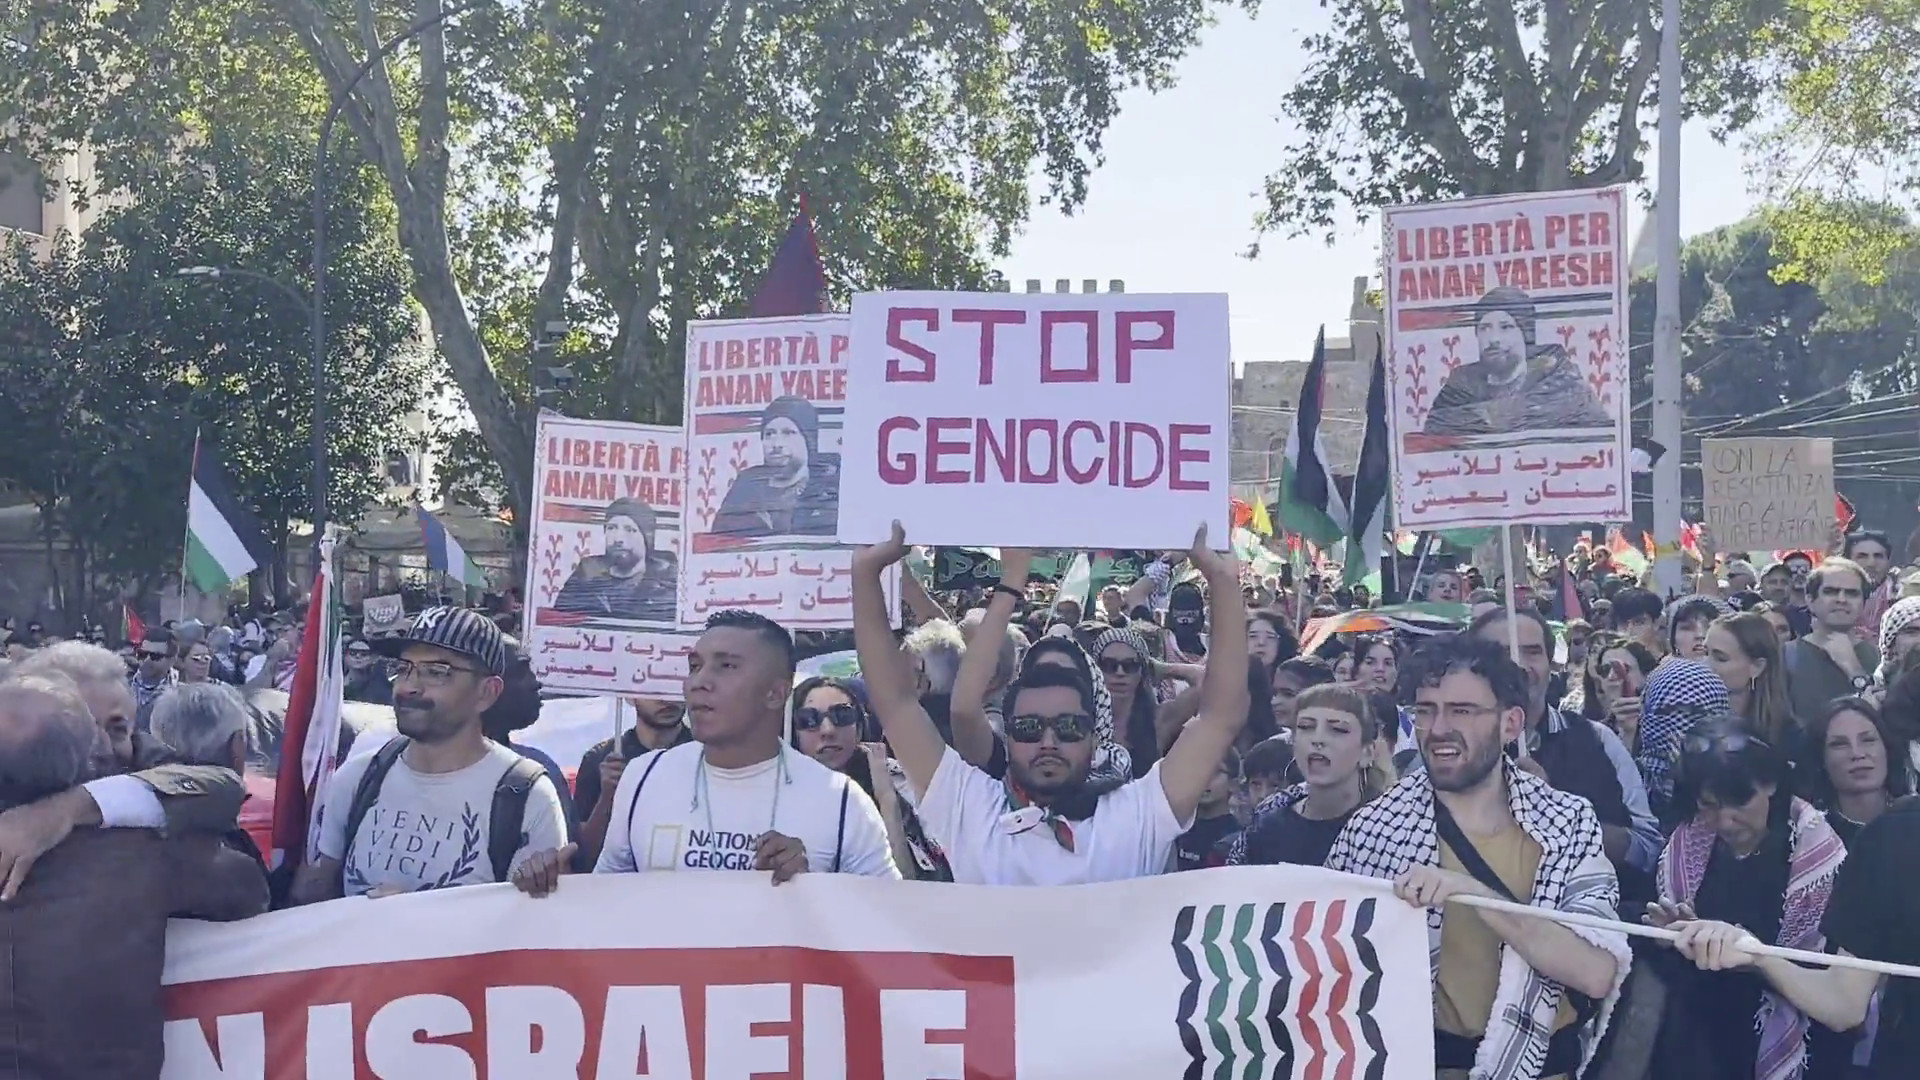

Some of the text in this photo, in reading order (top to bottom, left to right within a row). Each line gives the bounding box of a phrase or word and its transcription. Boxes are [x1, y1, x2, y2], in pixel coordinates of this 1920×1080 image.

[1397, 211, 1612, 263] LIBERTÀ PER
[1397, 251, 1613, 302] ANAN YAEESH
[698, 330, 820, 371] LIBERTÀ
[885, 307, 1176, 386] STOP
[695, 372, 773, 407] ANAN
[548, 437, 660, 472] LIBERTÀ
[877, 415, 1212, 491] GENOCIDE
[1513, 448, 1614, 476] الحرية
[1766, 447, 1796, 474] LA
[544, 469, 617, 501] ANAN
[1411, 479, 1617, 514] عنان يعيش
[373, 809, 455, 841] VENI
[371, 830, 441, 859] VIDI
[684, 849, 753, 871] GEOGR
[367, 851, 428, 879] VICI
